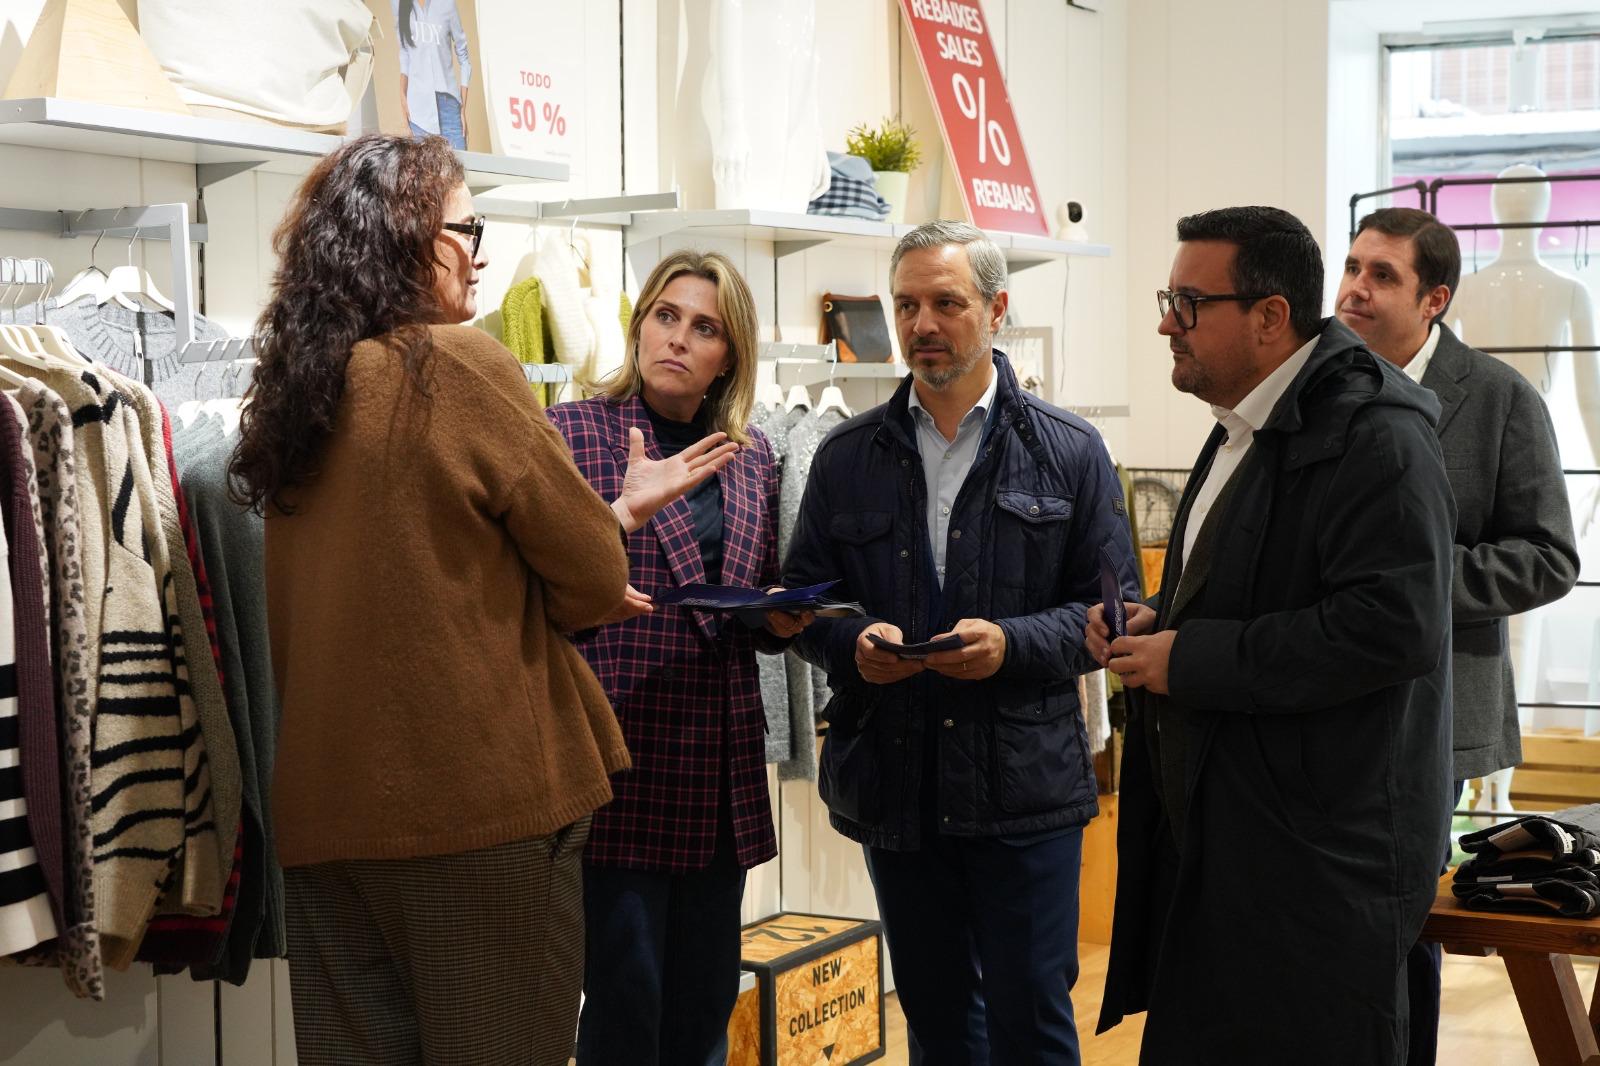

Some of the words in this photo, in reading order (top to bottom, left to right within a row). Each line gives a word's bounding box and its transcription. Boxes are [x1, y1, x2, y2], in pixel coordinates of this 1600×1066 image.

[411, 21, 442, 45] JDY
[911, 0, 983, 35] REBAIXES
[936, 31, 983, 67] SALES
[520, 70, 551, 89] TODO
[509, 97, 536, 132] 50
[543, 102, 566, 136] %
[952, 73, 1011, 167] %
[972, 178, 1035, 214] REBAJAS
[812, 957, 842, 987] NEW
[789, 986, 865, 1037] COLLECTION
